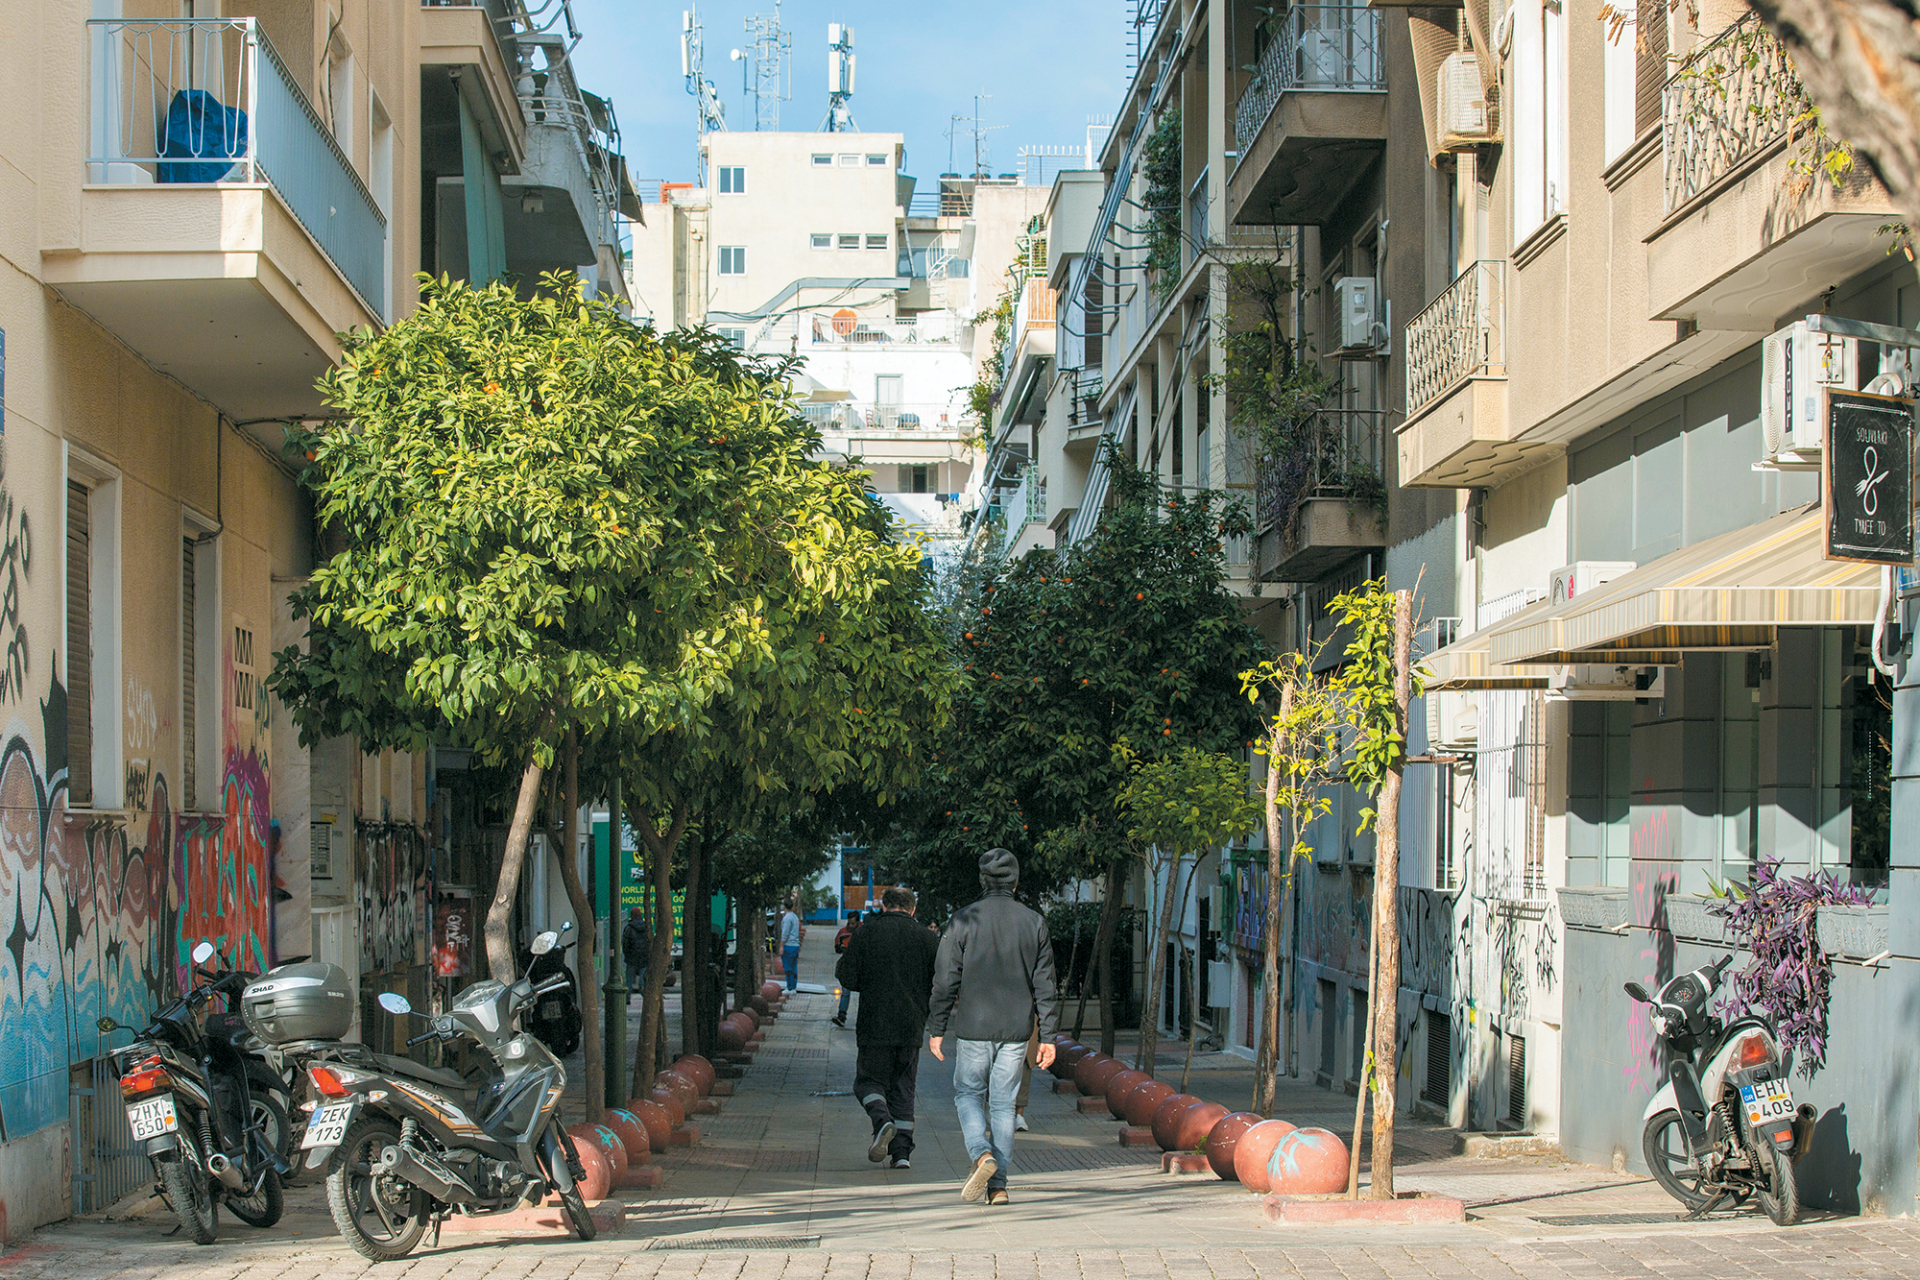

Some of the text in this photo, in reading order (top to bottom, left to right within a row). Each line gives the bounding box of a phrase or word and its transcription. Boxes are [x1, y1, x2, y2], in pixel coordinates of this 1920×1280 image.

[251, 984, 275, 995] SHAD
[1753, 1079, 1786, 1099] EHY
[132, 1102, 161, 1121] ZHX
[320, 1106, 350, 1124] ZEK
[1762, 1099, 1795, 1117] 409
[136, 1117, 164, 1136] 650
[316, 1126, 343, 1142] 173
